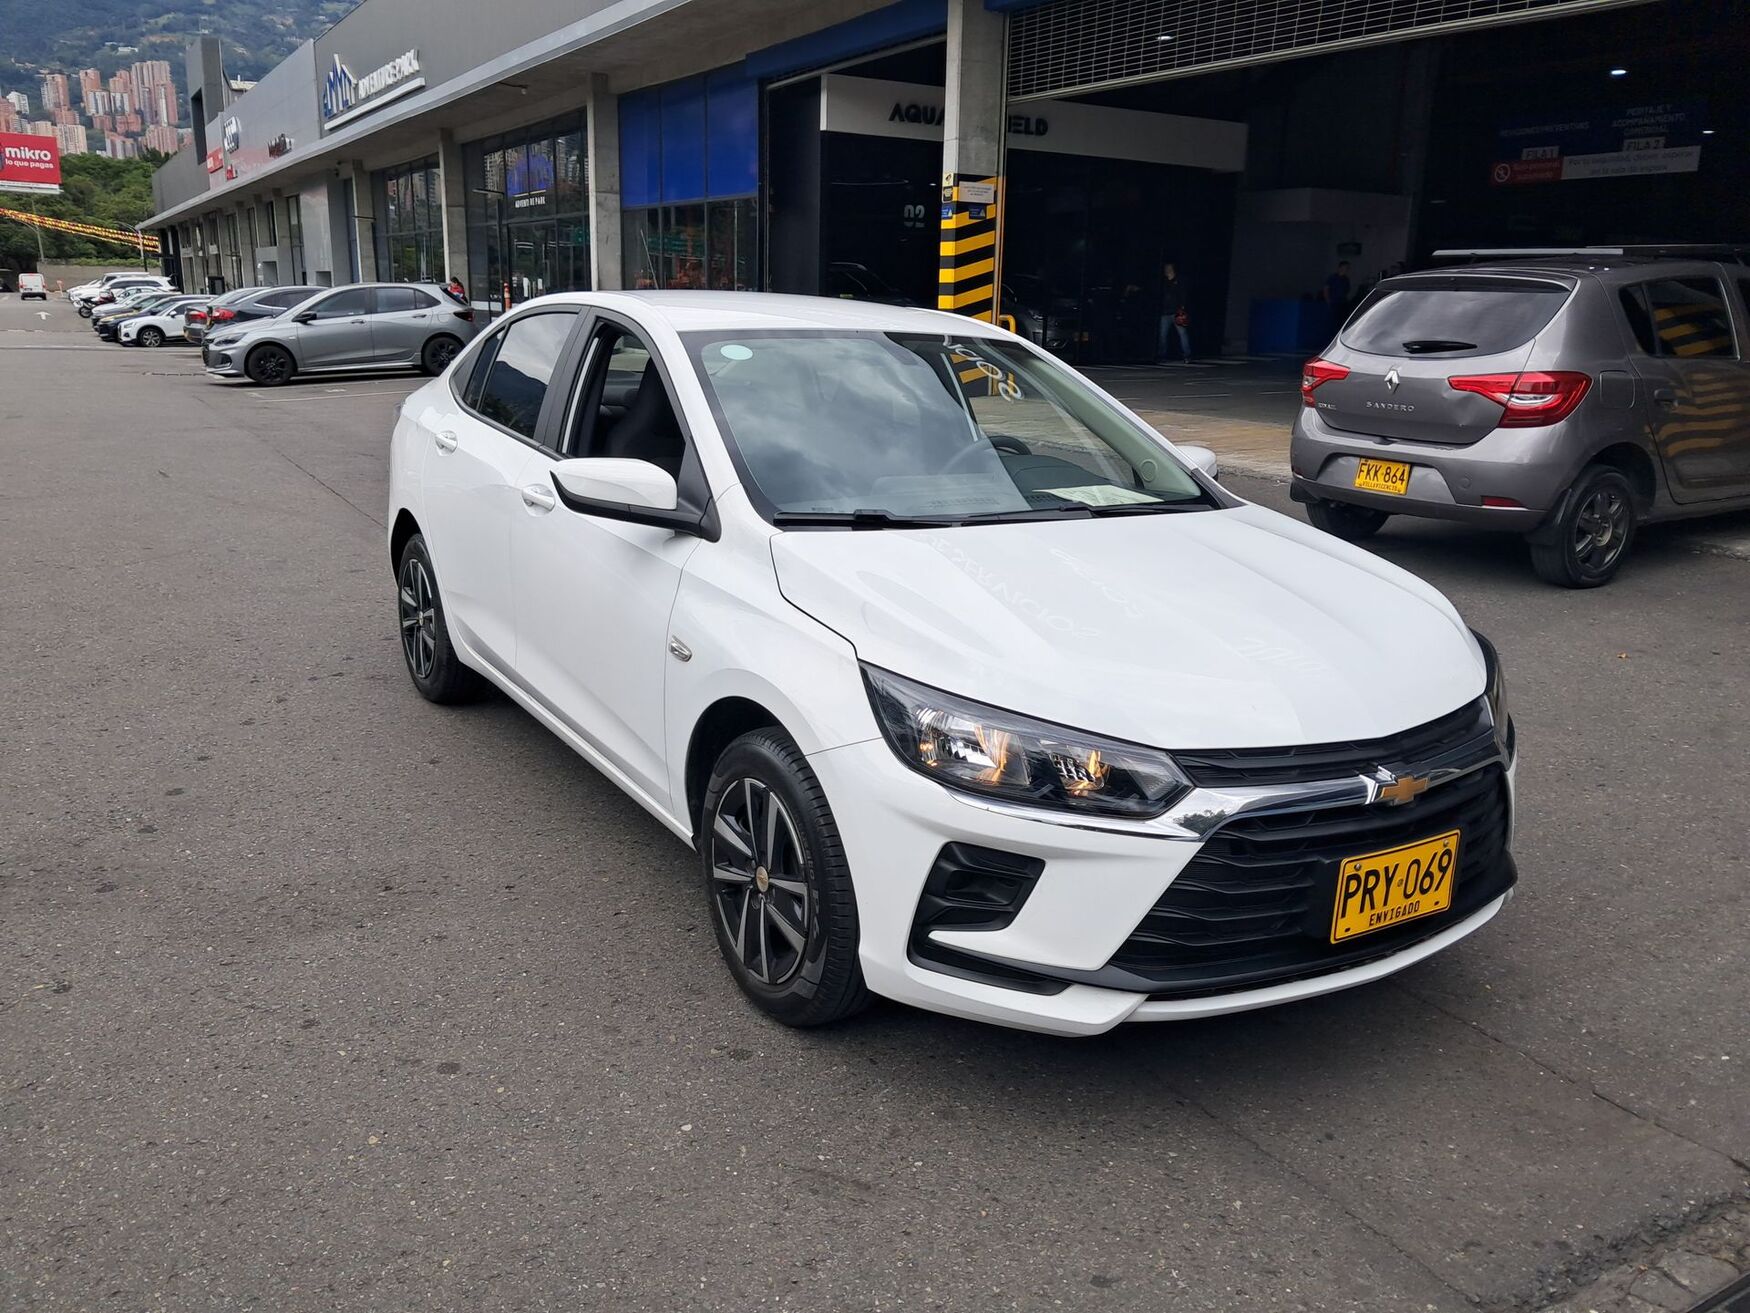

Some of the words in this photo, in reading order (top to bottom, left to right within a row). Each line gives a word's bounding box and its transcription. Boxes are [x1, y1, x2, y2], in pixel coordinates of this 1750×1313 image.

[5, 147, 51, 161] mikro
[30, 161, 54, 169] pagas
[904, 204, 925, 228] 02
[1366, 401, 1415, 412] SANDERO
[1358, 463, 1382, 481] FKK
[1384, 466, 1406, 486] 864
[1341, 863, 1400, 918] PRY
[1403, 848, 1453, 899] 069
[1369, 900, 1420, 926] ENVIGADO
